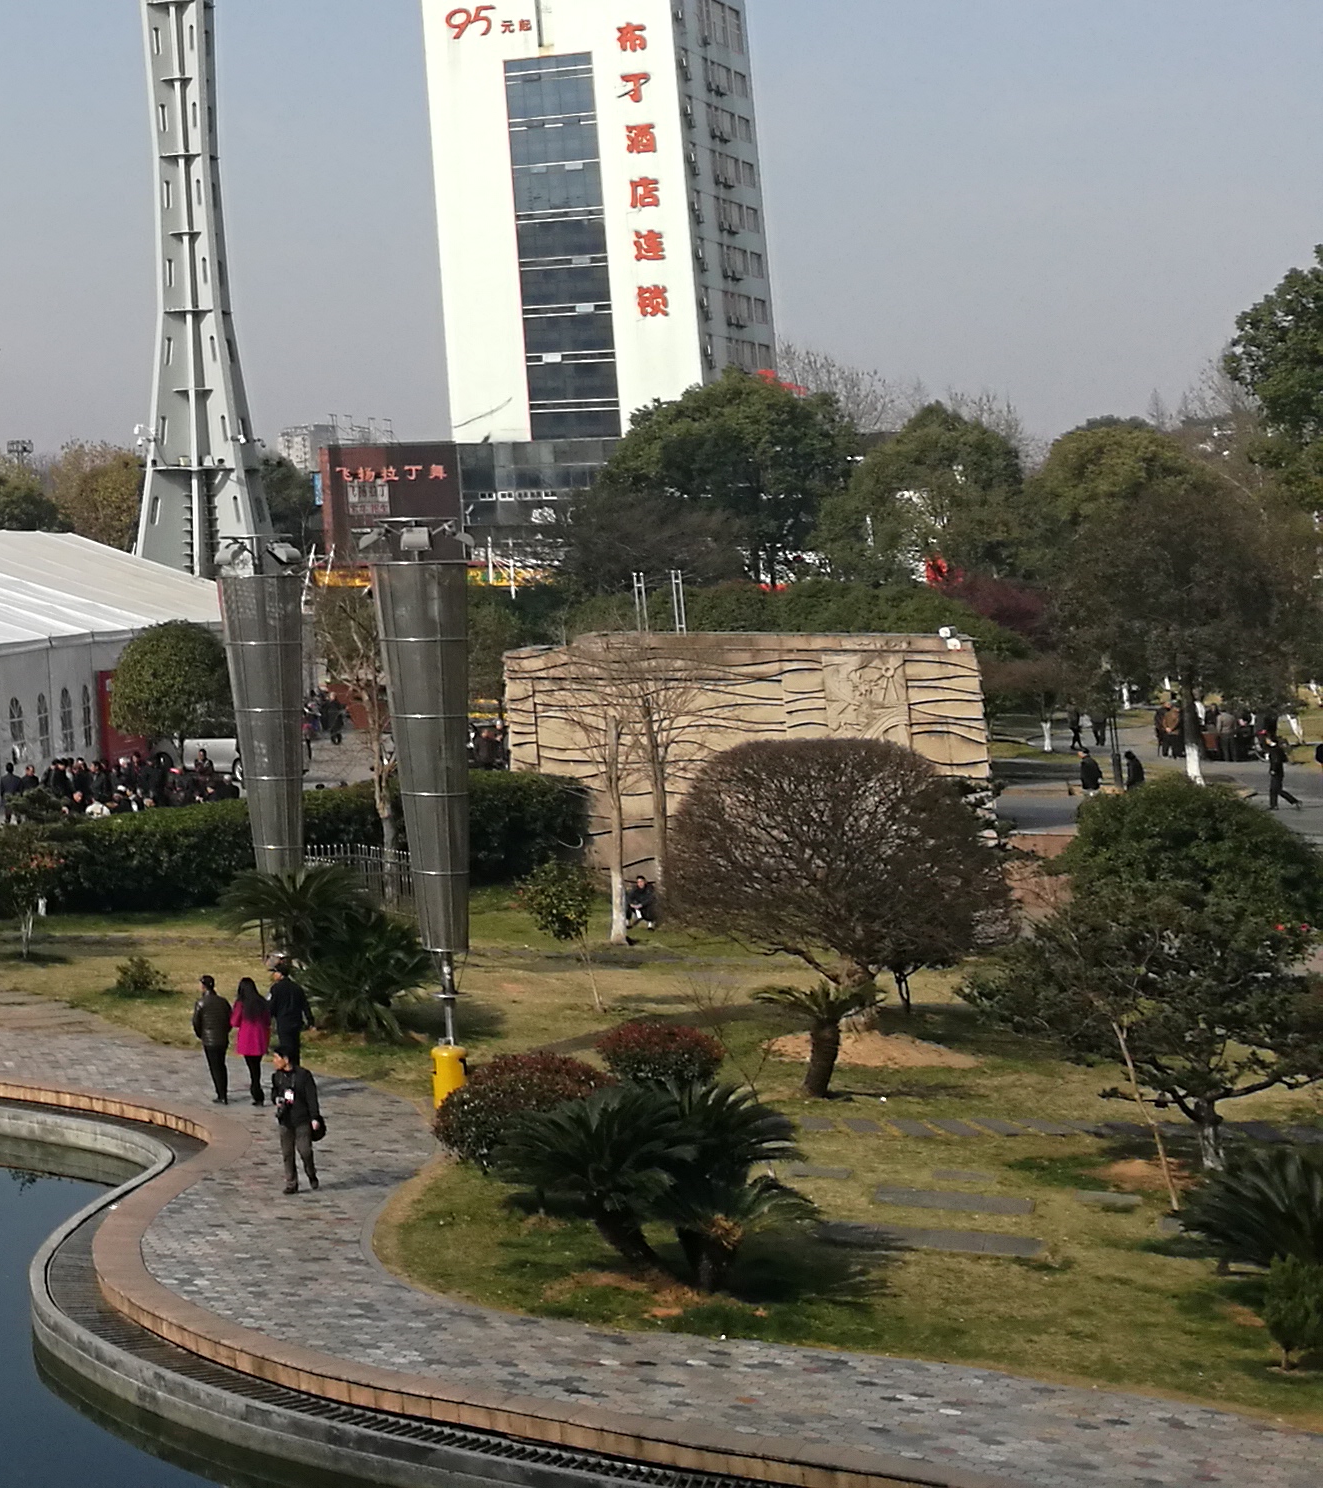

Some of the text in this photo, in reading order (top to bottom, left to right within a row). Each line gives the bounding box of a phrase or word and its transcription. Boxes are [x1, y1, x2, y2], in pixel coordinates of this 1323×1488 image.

[616, 22, 669, 317] 布丁酒店连锁
[335, 464, 447, 483] 飞扬拉丁舞
